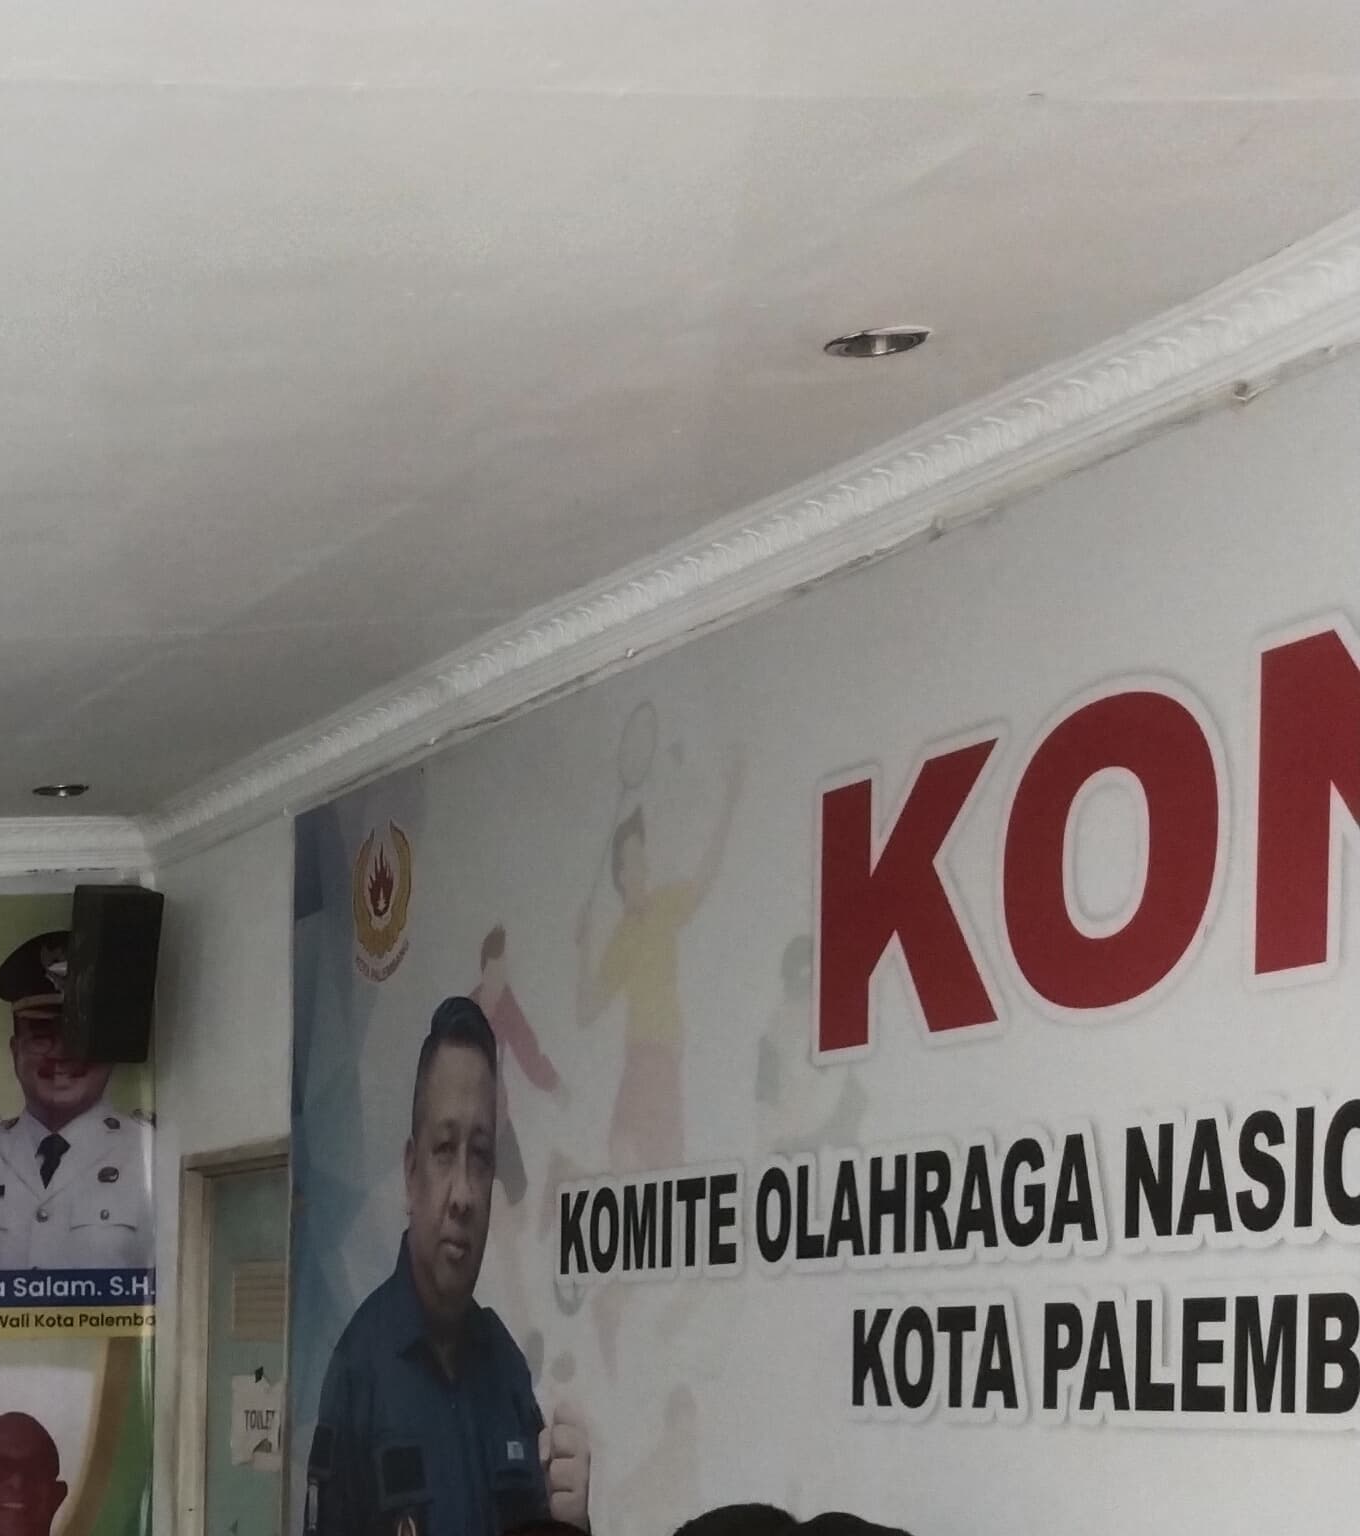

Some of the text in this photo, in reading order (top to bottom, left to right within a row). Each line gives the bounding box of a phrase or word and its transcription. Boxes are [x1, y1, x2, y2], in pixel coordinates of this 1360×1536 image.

[559, 1173, 738, 1276] KOMITE
[756, 1133, 1098, 1265] OLAHRAGA
[34, 1313, 74, 1328] Kota
[851, 1293, 1360, 1414] KOTA PALEMB
